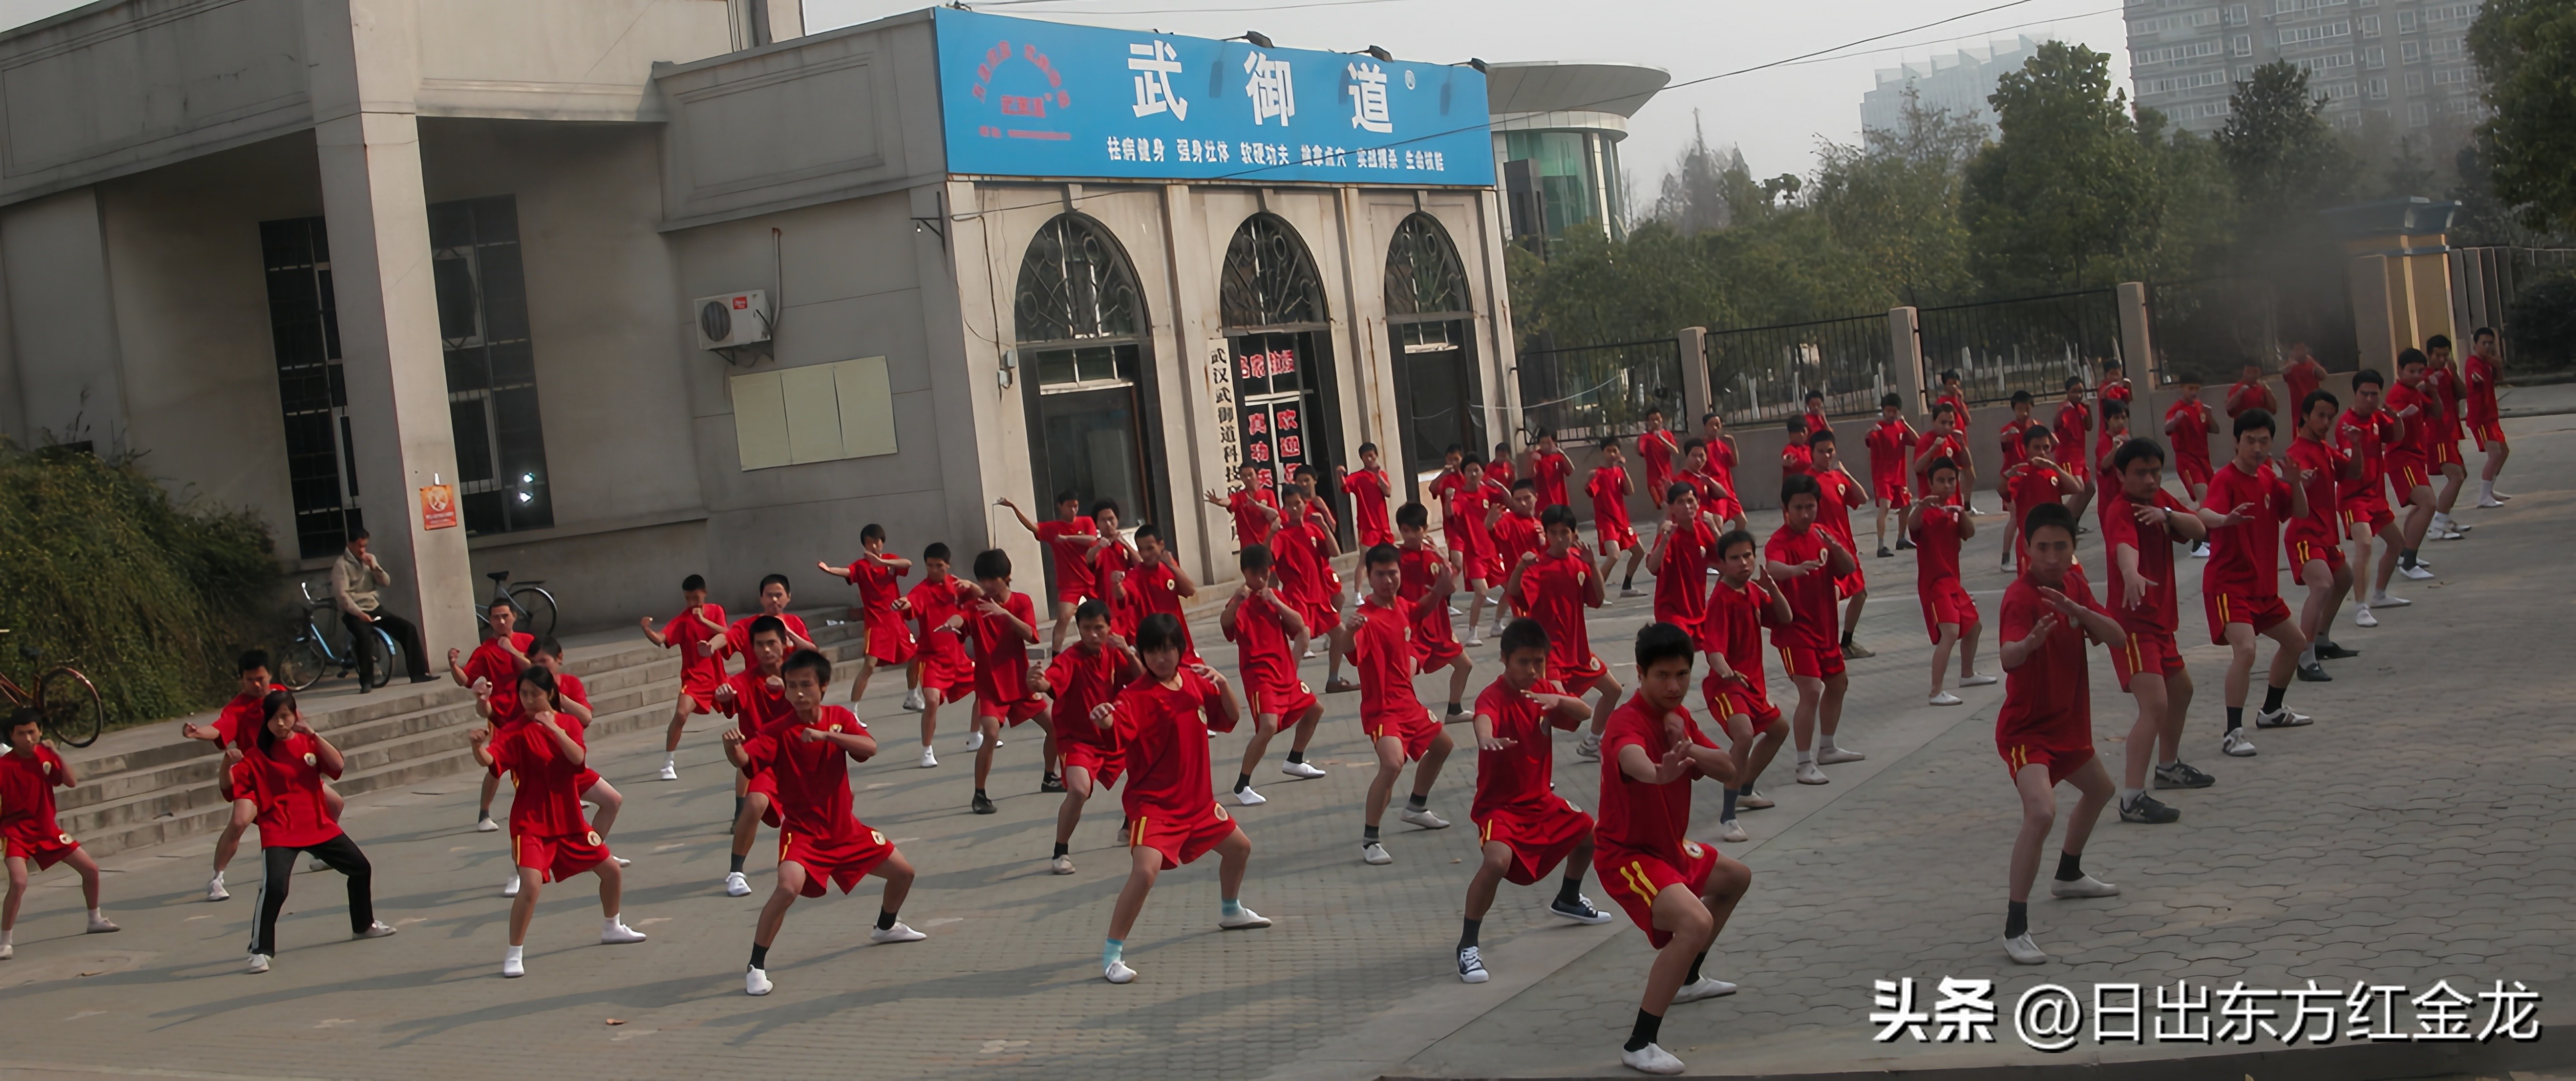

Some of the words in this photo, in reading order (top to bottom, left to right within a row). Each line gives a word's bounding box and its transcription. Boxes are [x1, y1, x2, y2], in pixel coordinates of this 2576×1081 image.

[1128, 40, 1392, 133] 武御道
[1107, 136, 1164, 162] 祛病健身
[1177, 138, 1230, 163] 强身壮体
[1240, 141, 1289, 165] 软硬功夫
